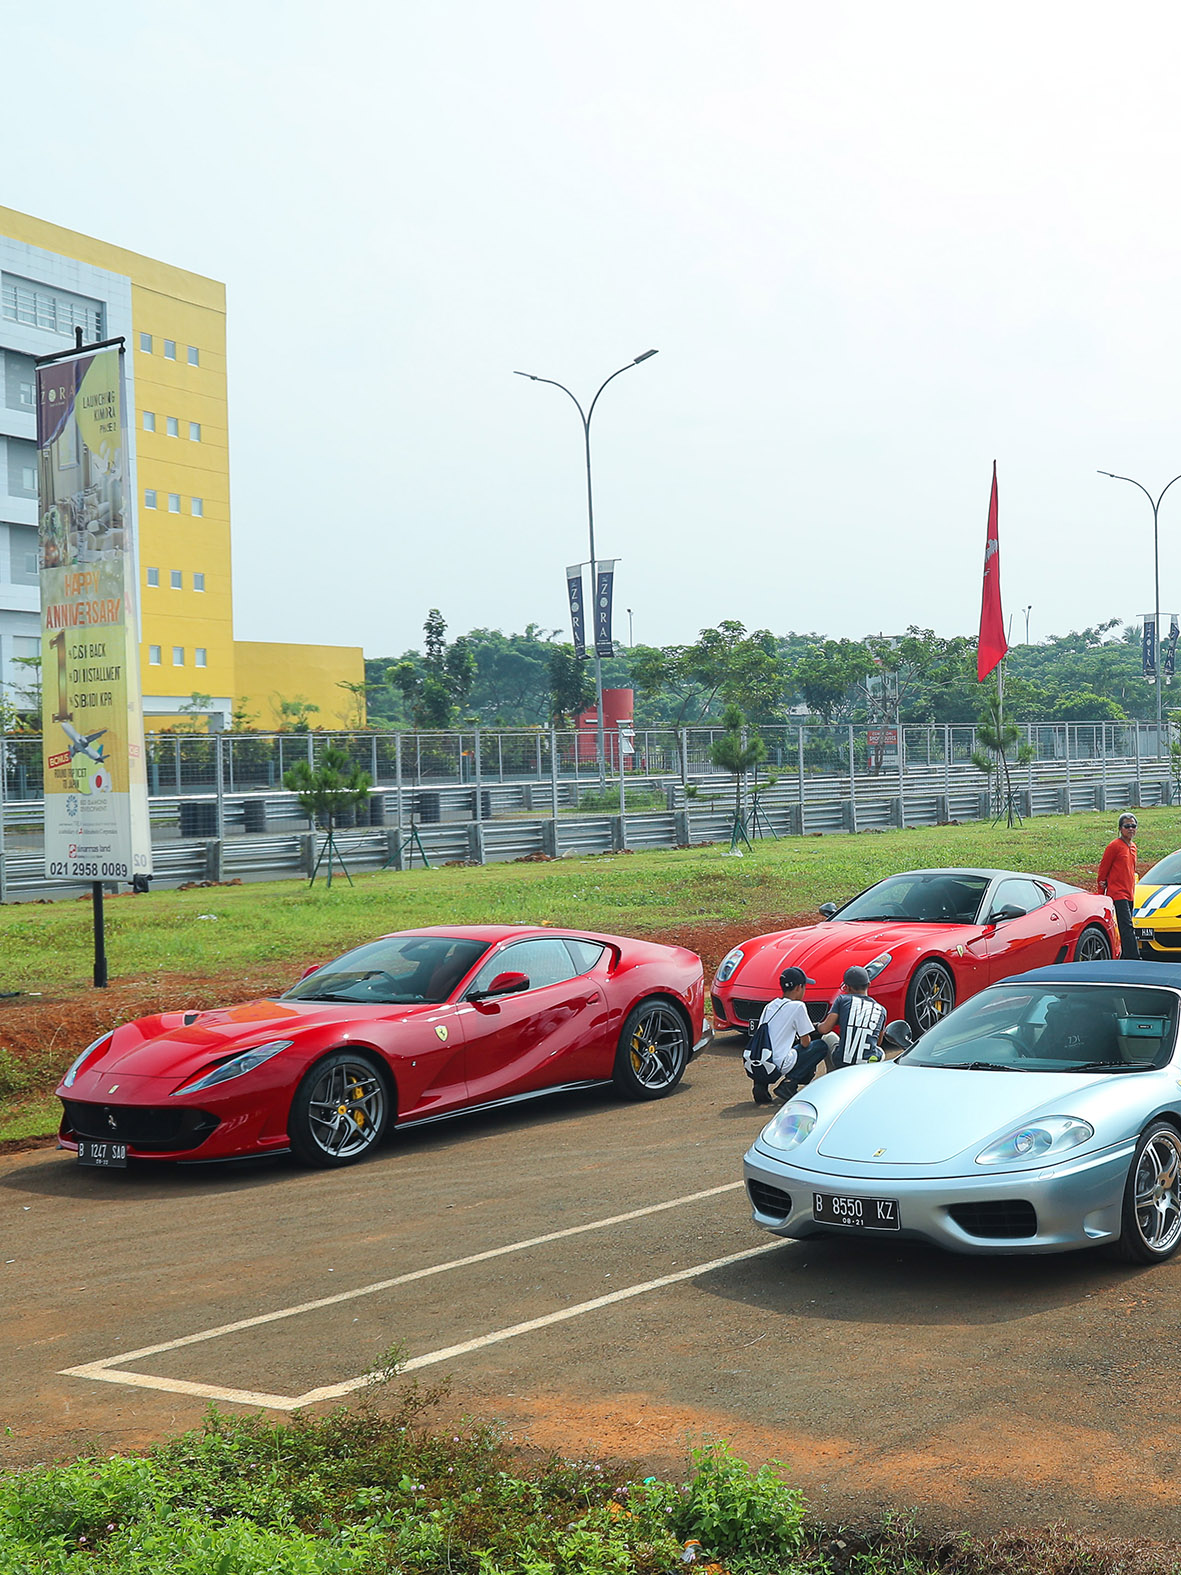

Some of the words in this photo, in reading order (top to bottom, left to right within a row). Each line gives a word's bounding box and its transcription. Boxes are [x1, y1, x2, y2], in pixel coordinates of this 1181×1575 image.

[64, 570, 100, 597] HAPPY
[46, 598, 121, 629] ANNIVERSARY
[50, 862, 68, 876] 021
[72, 862, 98, 876] 2958
[101, 863, 127, 877] 0089
[79, 1143, 84, 1157] B
[91, 1144, 107, 1158] 1247
[816, 1194, 823, 1211] B
[832, 1197, 863, 1217] 8550
[876, 1201, 894, 1219] KZ
